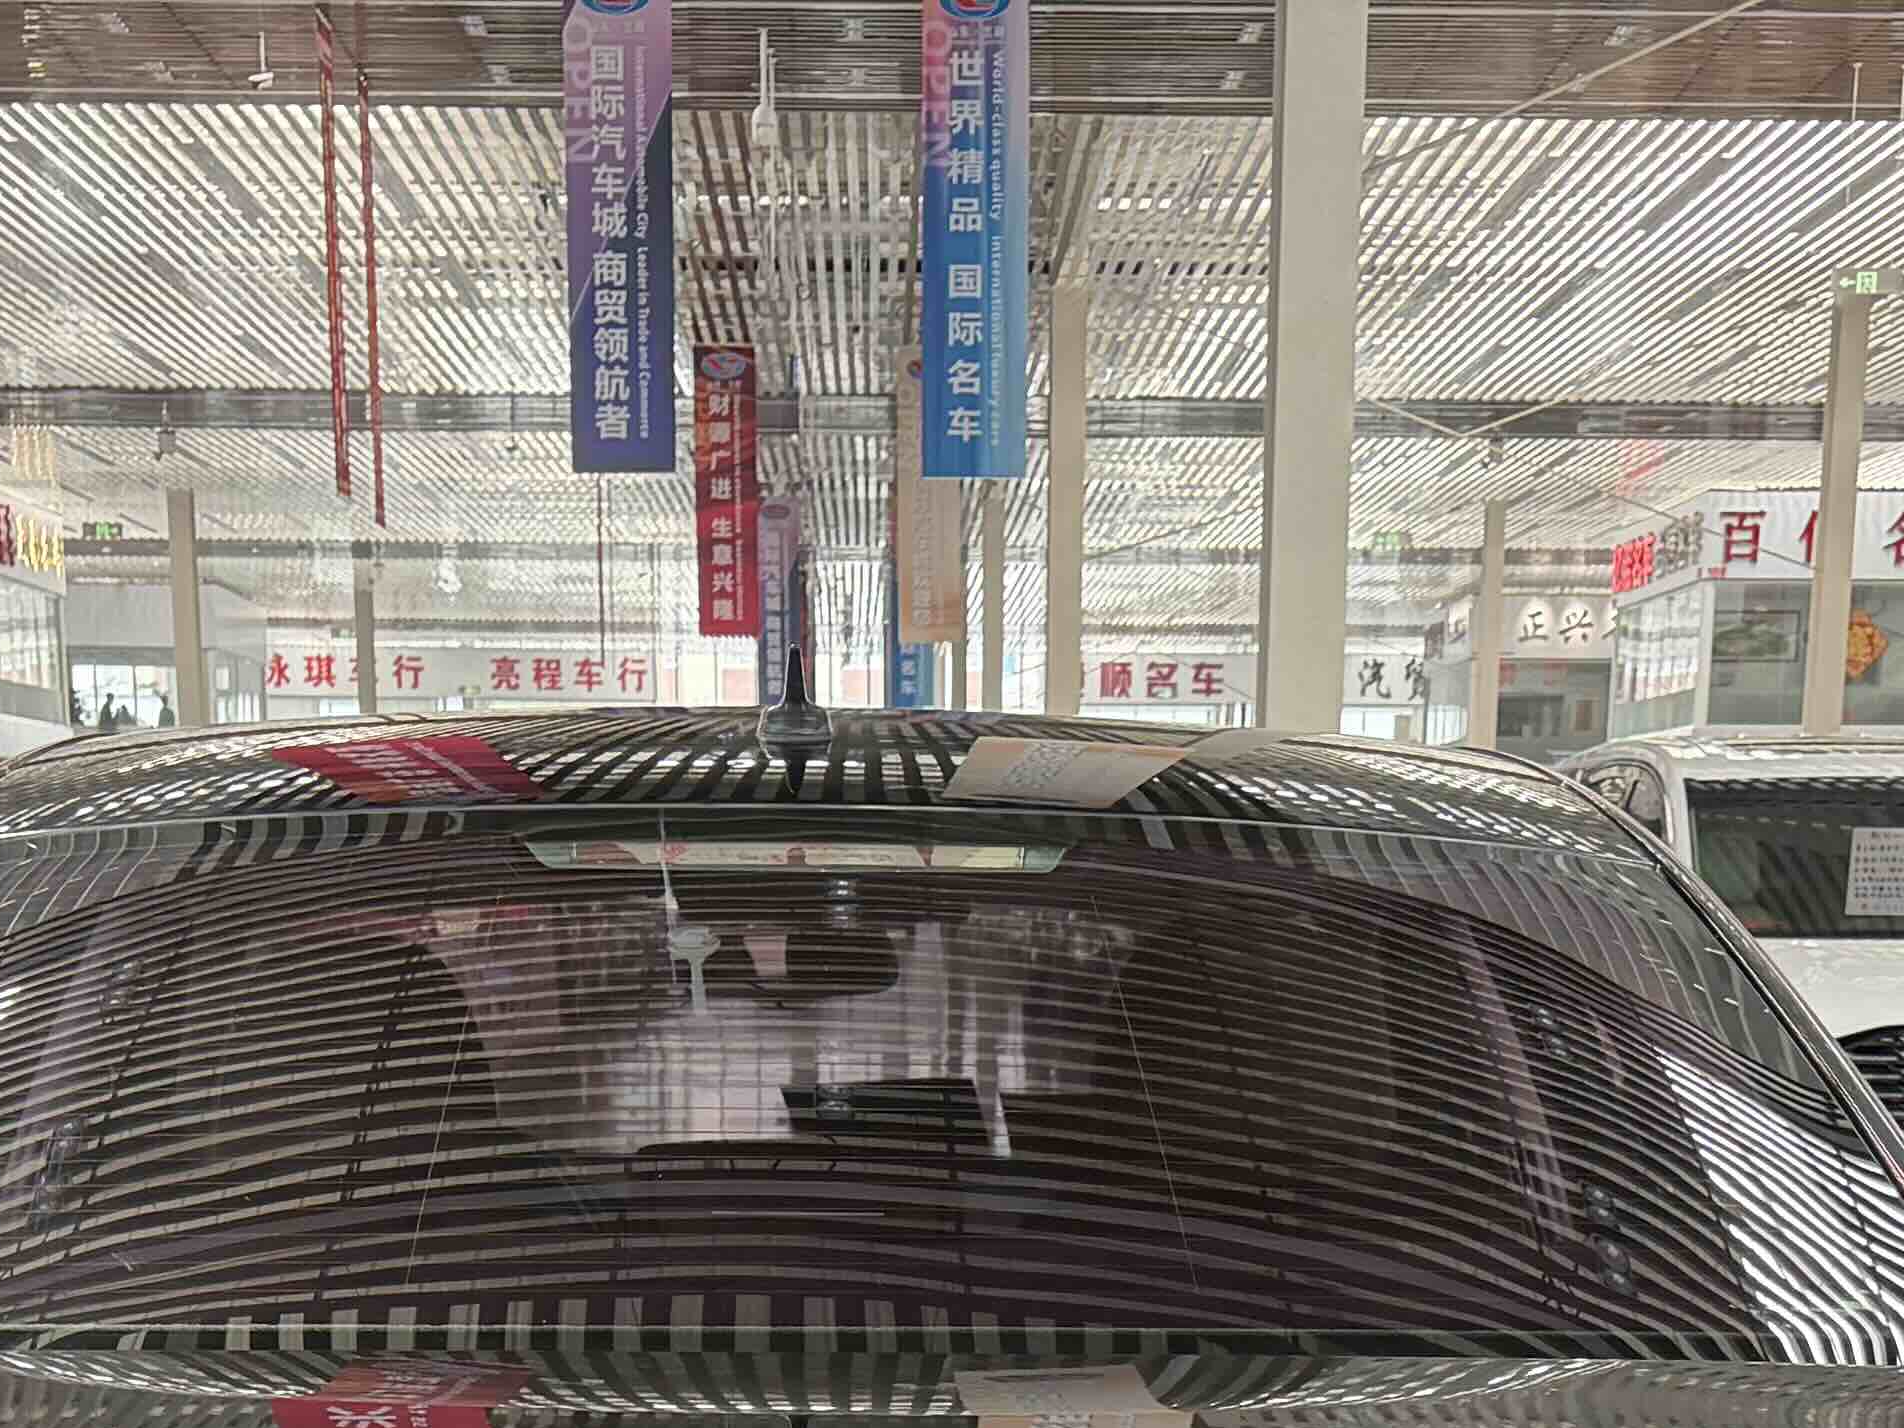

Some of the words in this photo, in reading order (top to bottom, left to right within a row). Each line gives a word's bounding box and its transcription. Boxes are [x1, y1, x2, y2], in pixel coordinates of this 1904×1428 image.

[591, 45, 627, 239] 国际汽车城
[947, 51, 984, 233] 世界精品
[988, 159, 1007, 221] quality
[592, 250, 631, 441] 商贸领航者
[946, 264, 984, 443] 国际名车
[490, 655, 649, 692] 亮程车行
[1080, 661, 1225, 700] 顺名车
